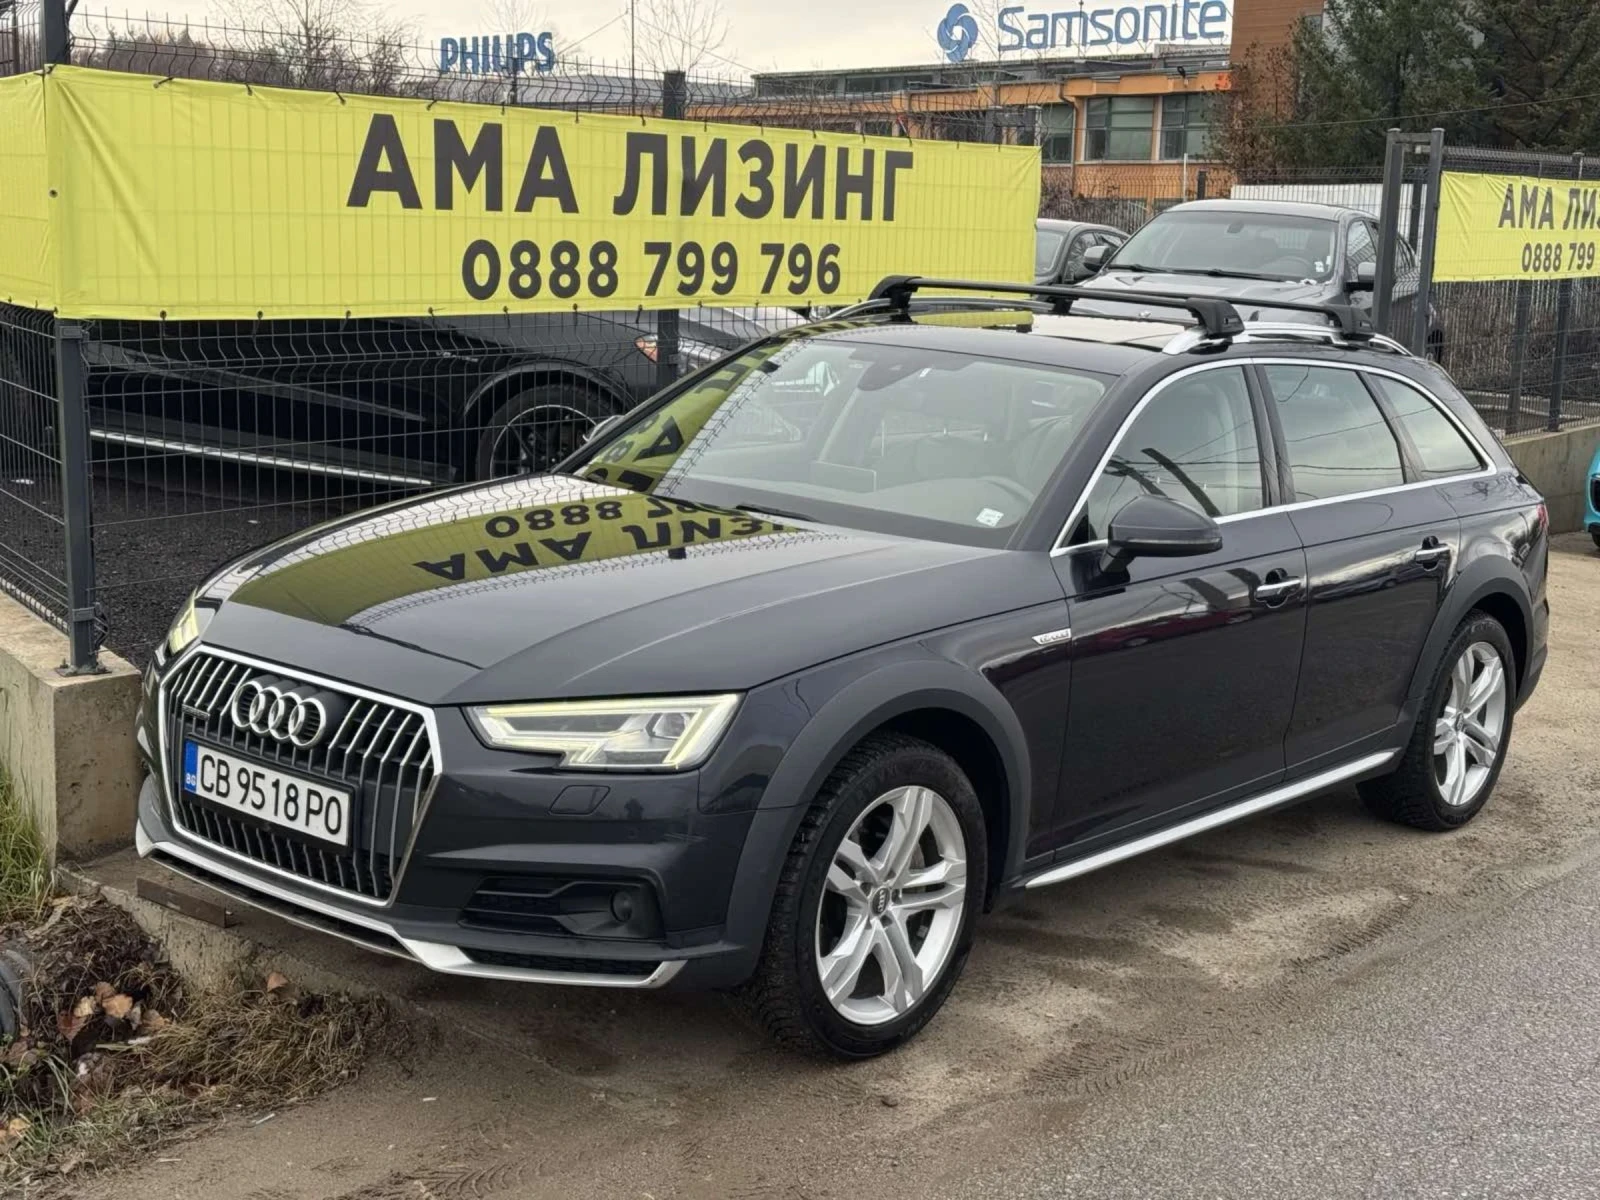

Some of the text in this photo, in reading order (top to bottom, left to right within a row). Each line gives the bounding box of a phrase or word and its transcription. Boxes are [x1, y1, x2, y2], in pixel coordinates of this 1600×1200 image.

[998, 0, 1226, 51] Samsonite
[440, 32, 555, 74] PHILIPS
[346, 113, 914, 222] АМА ЛИЗИНГ
[1498, 184, 1600, 231] АМА ЛИ
[462, 239, 841, 300] 0888 799 796
[1521, 242, 1596, 272] 0888 799
[237, 767, 299, 821] 9518
